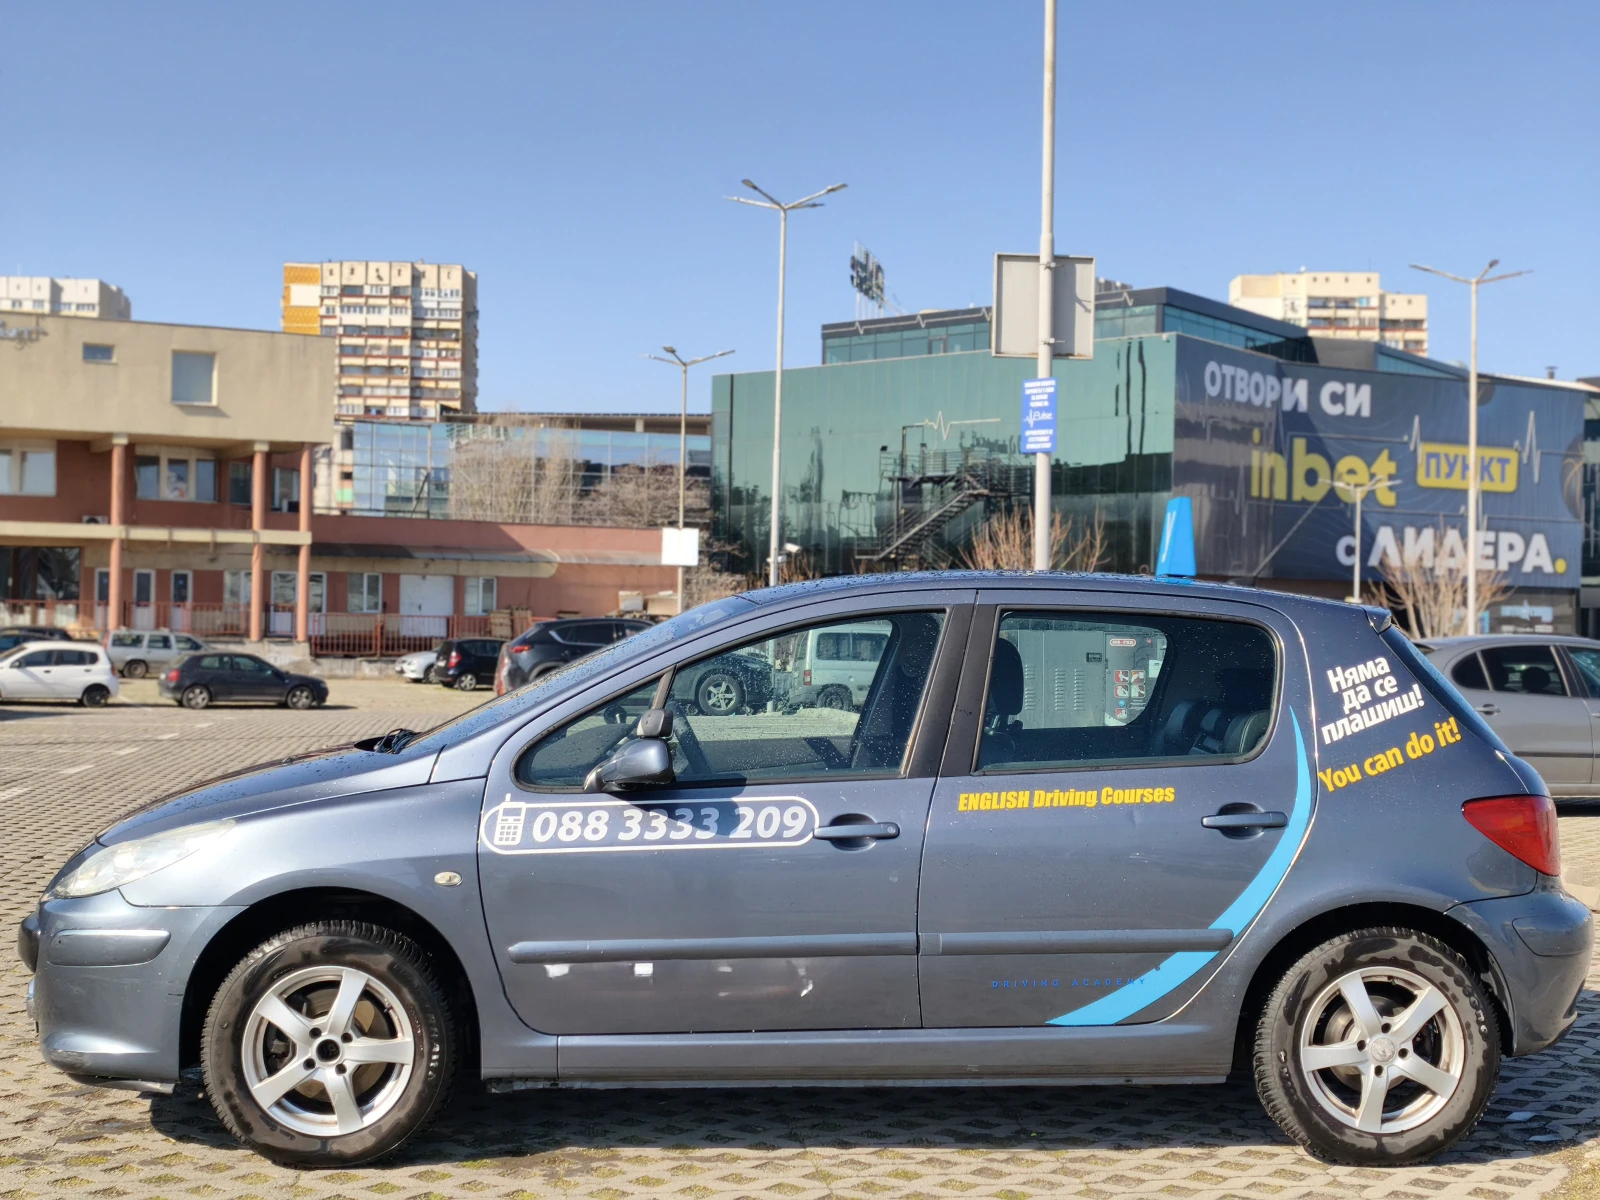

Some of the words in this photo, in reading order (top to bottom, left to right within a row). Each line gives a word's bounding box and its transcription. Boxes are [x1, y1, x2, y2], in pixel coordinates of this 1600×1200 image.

[1204, 360, 1308, 413] ОТВОРИ
[1320, 380, 1372, 418] СИ
[1250, 427, 1397, 507] inbet
[1327, 656, 1390, 693] Няма
[1374, 675, 1398, 697] се
[1321, 684, 1425, 745] плашиш!
[1318, 763, 1362, 793] You
[1364, 747, 1405, 776] can
[1405, 732, 1435, 759] do
[1434, 717, 1462, 747] it!
[958, 790, 1030, 811] ENGLISH
[1033, 789, 1098, 807] Driving
[1101, 787, 1175, 805] Courses
[532, 811, 610, 842] 088
[617, 807, 720, 841] 3333
[728, 805, 807, 839] 209
[992, 980, 1060, 988] DRIVING
[1071, 978, 1145, 987] ACADEMY
